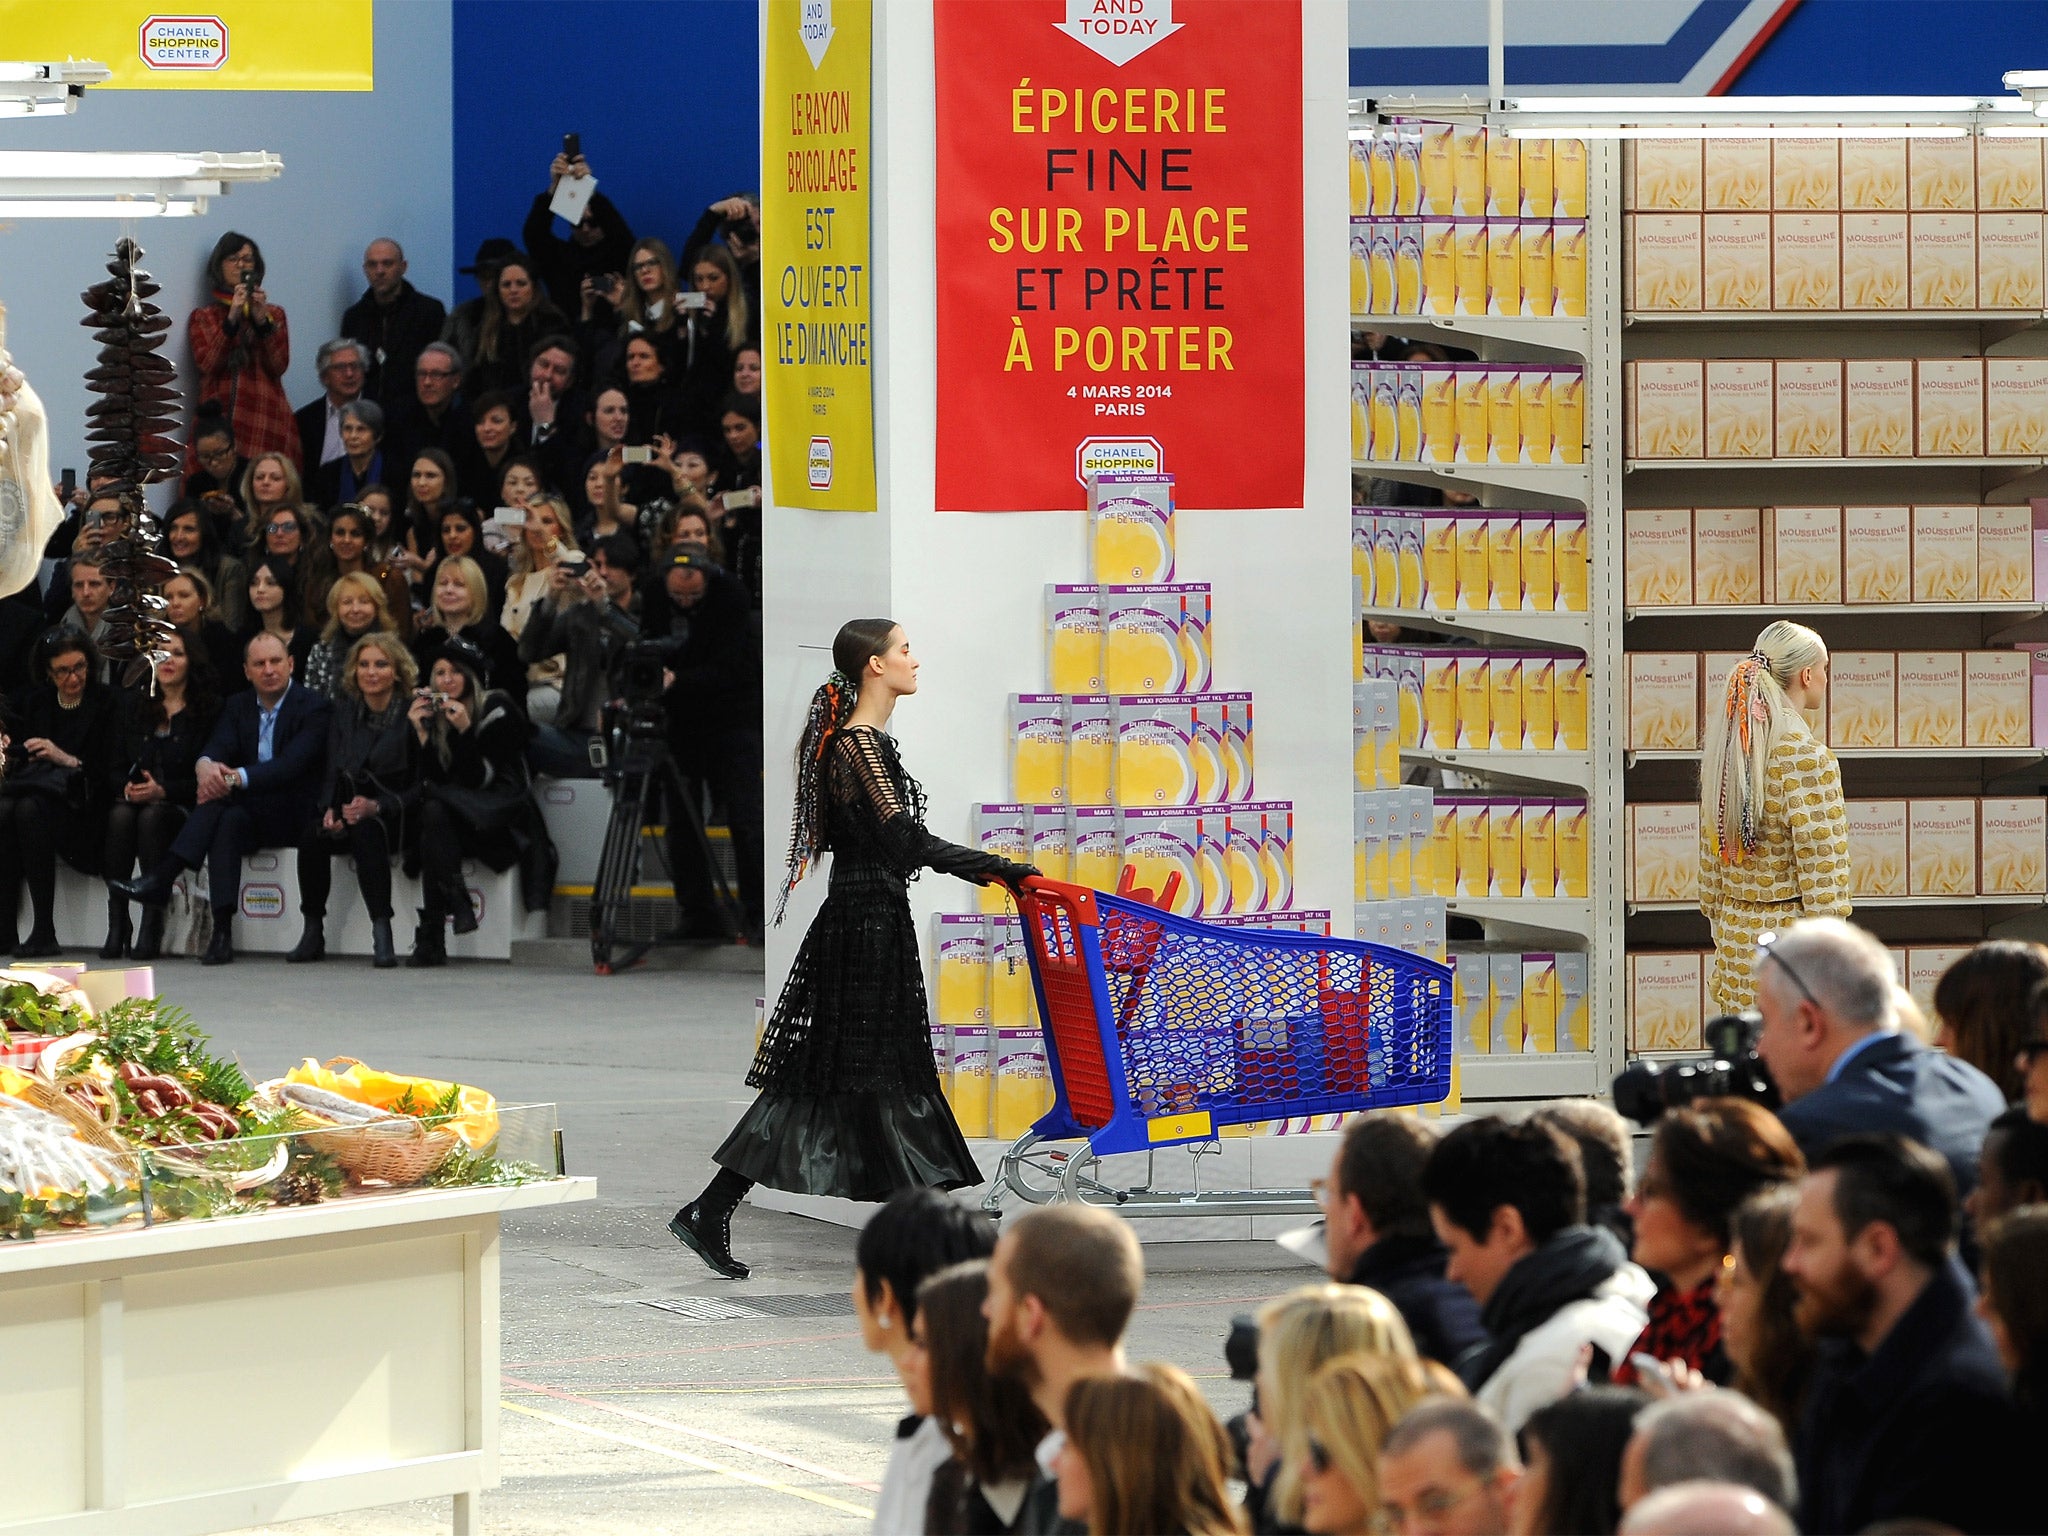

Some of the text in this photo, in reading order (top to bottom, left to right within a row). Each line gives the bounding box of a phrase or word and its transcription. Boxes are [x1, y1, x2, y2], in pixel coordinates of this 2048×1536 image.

[807, 4, 822, 19] AND
[1092, 0, 1143, 14] AND
[158, 28, 209, 36] CHANEL
[804, 24, 828, 39] TODAY
[1079, 19, 1159, 35] TODAY
[149, 38, 219, 47] SHOPPING
[158, 49, 209, 58] CENTER
[1012, 77, 1228, 134] ÉPICERIE
[791, 91, 850, 136] LE RAYON
[788, 148, 857, 193] BRICOLAGE
[1047, 149, 1193, 192] FINE
[806, 208, 835, 249] EST
[988, 206, 1249, 253] SUR PLACE
[1639, 232, 1698, 244] MOUSSELINE
[1708, 232, 1767, 244] MOUSSELINE
[1777, 231, 1836, 244] MOUSSELINE
[1846, 231, 1904, 243] MOUSSELINE
[1914, 231, 1973, 243] MOUSSELINE
[1982, 231, 2040, 243] MOUSSELINE
[781, 265, 862, 307] OUVERT
[1016, 256, 1225, 311] ET PRÊTE
[777, 323, 793, 364] LE
[1003, 316, 1234, 372] À PORTER
[1641, 379, 1699, 391] MOUSSELINE
[1710, 379, 1769, 391] MOUSSELINE
[1780, 379, 1839, 391] MOUSSELINE
[1851, 379, 1909, 390] MOUSSELINE
[1922, 378, 1980, 390] MOUSSELINE
[1066, 385, 1172, 398] 4 MARS 2014
[1094, 403, 1146, 416] PARIS
[1094, 449, 1145, 457] CHANEL
[1085, 459, 1155, 468] SHOPPING
[1130, 486, 1141, 499] 4
[1629, 527, 1688, 539] MOUSSELINE
[1699, 526, 1757, 538] MOUSSELINE
[1780, 525, 1838, 538] MOUSSELINE
[1850, 525, 1907, 537] MOUSSELINE
[1917, 524, 1974, 536] MOUSSELINE
[1980, 524, 2029, 535] OUSSELINE
[1141, 597, 1152, 609] 4
[1634, 672, 1694, 683] MOUSSELINE
[1833, 670, 1891, 681] MOUSSELINE
[1902, 669, 1960, 681] MOUSSELINE
[1969, 669, 2027, 681] MOUSSELINE
[1152, 708, 1163, 720] 4
[1157, 820, 1168, 833] 4
[1638, 822, 1697, 834] MOUSSELINE
[1913, 817, 1972, 829] MOUSSELINE
[1985, 816, 2043, 828] MOUSSELINE
[1638, 971, 1697, 984] MOUSSELINE
[1031, 1042, 1042, 1054] 4
